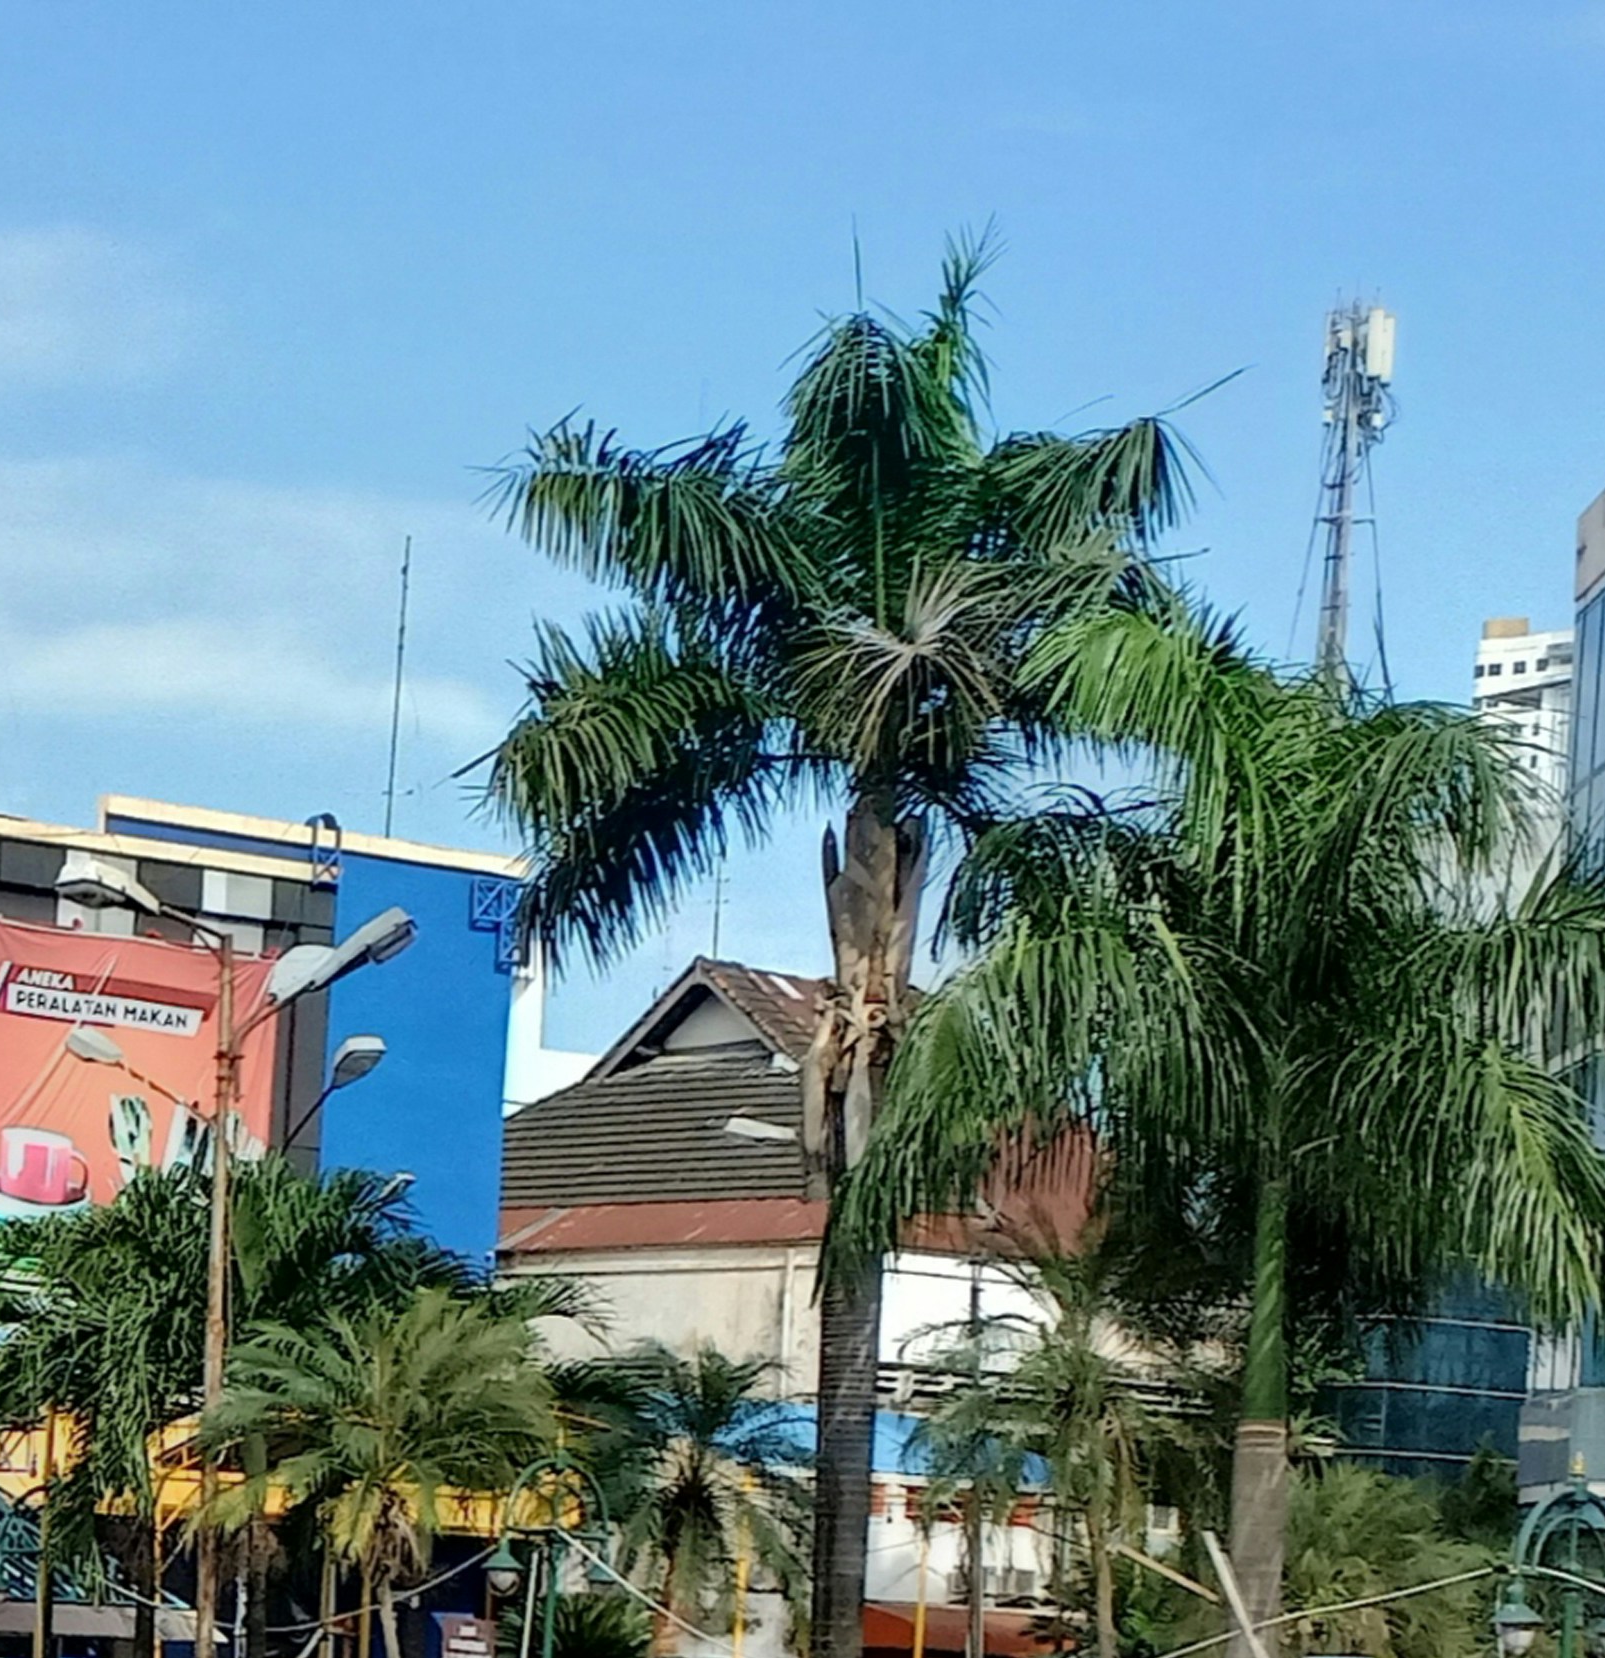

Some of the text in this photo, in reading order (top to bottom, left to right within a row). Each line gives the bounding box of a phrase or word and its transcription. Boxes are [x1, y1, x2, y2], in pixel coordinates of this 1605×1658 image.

[16, 967, 76, 992] ANEKA
[15, 988, 189, 1030] PERALATAN MAKAN
